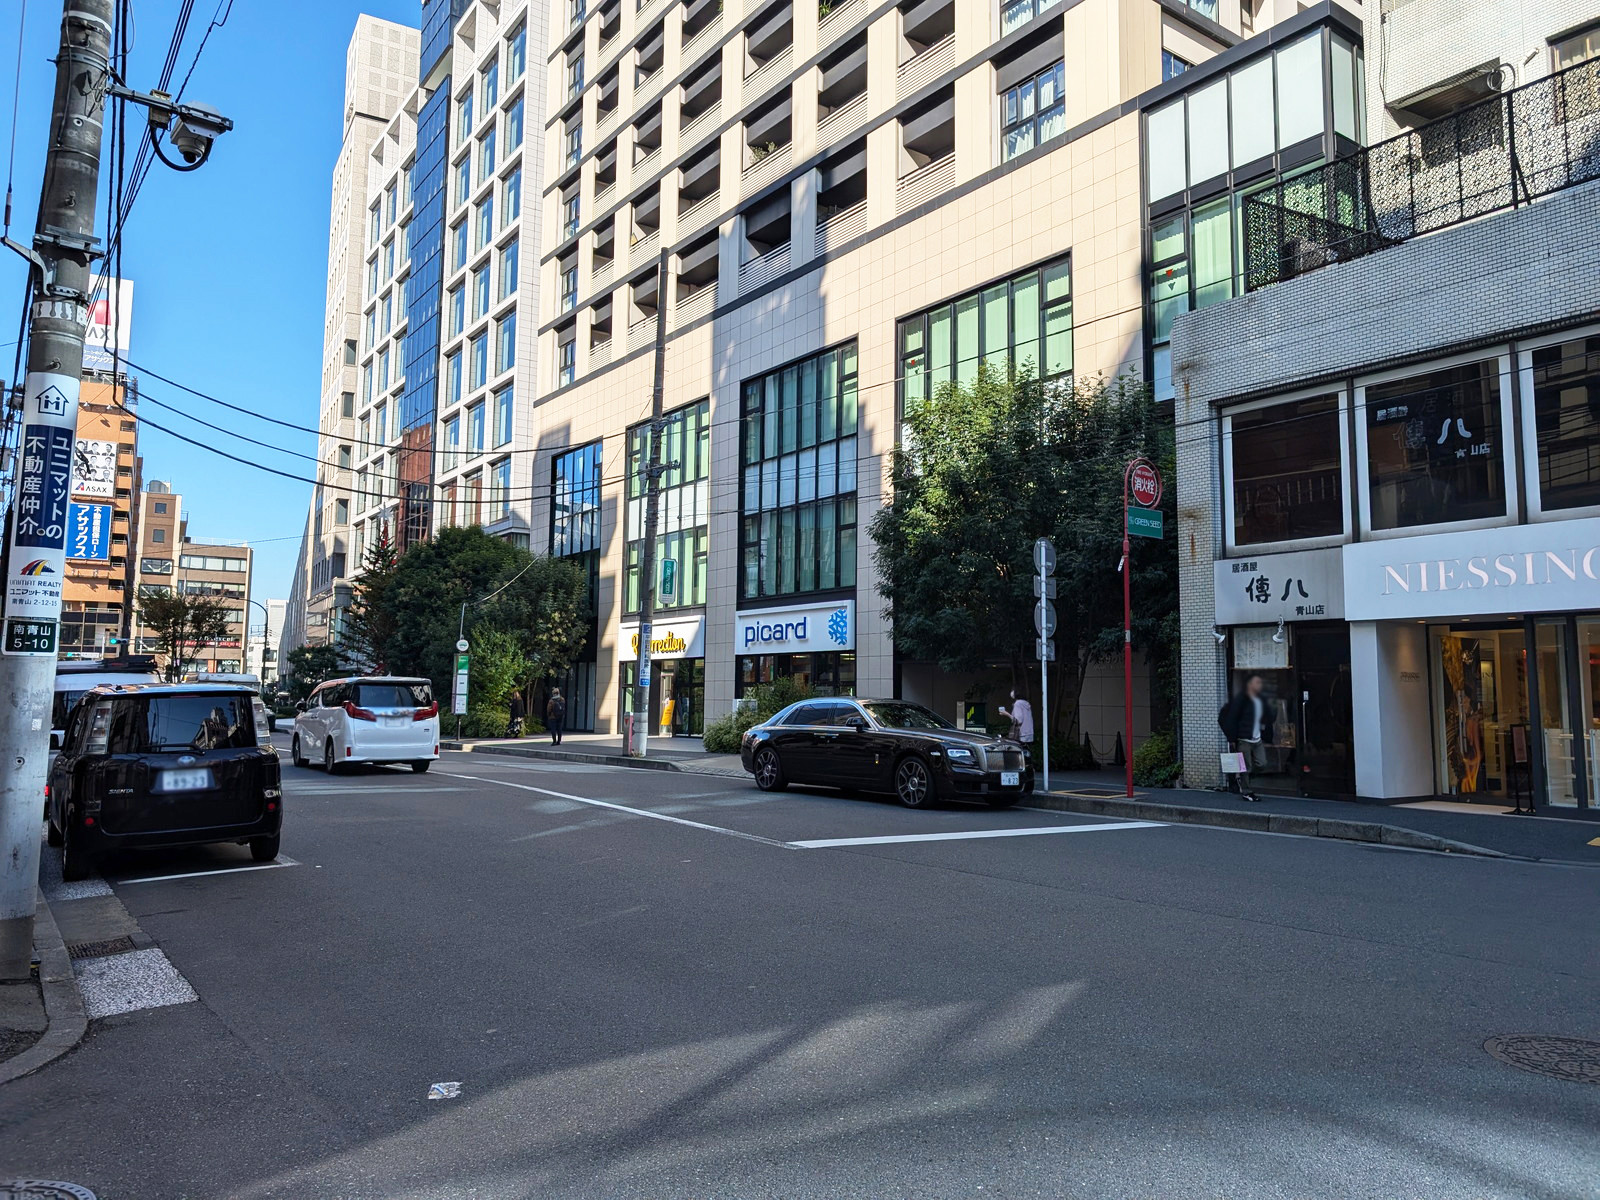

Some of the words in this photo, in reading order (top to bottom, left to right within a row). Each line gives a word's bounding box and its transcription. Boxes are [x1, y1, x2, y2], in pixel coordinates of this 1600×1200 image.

[46, 436, 70, 540] ユニマットの
[1134, 476, 1154, 494] 消火栓
[74, 504, 90, 557] アサックス
[1231, 561, 1258, 574] 居酒屋
[37, 580, 62, 588] REALTY
[1295, 604, 1325, 616] 青山店
[13, 624, 51, 636] 南青山
[745, 616, 807, 648] picard
[14, 638, 49, 649] 5-10
